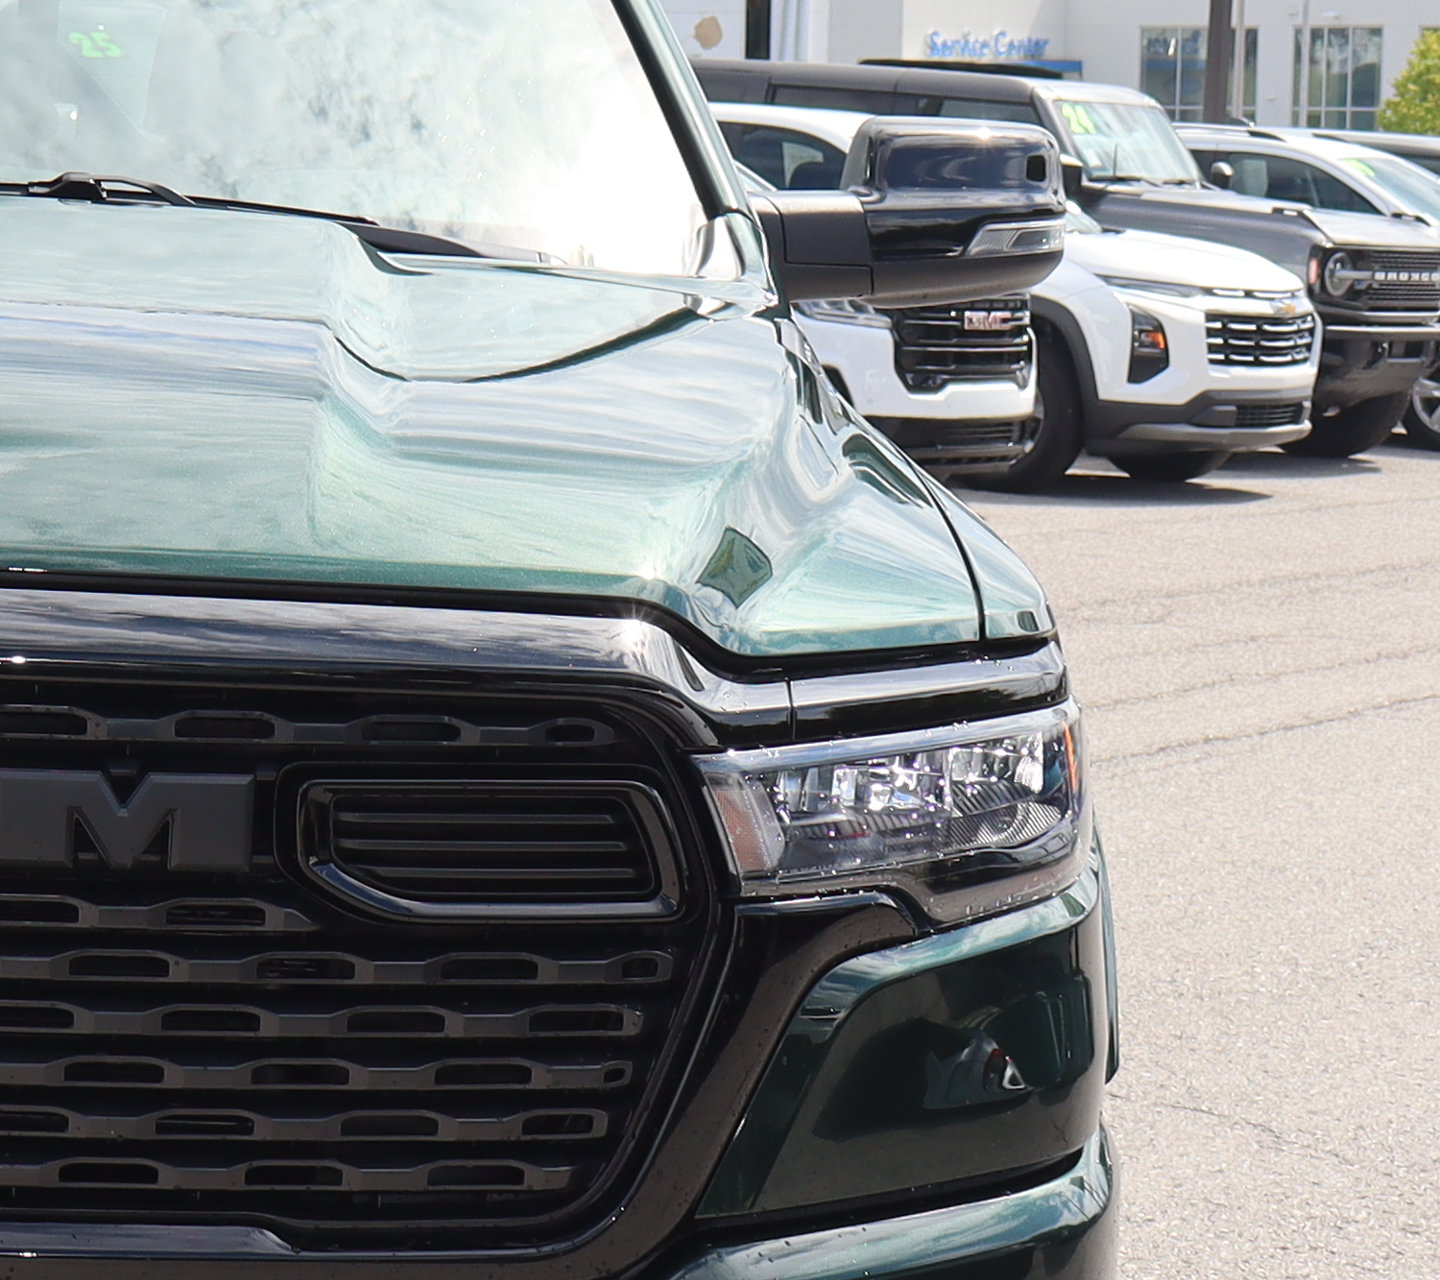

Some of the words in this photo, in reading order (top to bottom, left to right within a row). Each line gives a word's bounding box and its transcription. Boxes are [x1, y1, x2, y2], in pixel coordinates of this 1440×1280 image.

[68, 30, 123, 58] 25
[928, 30, 990, 58] Service
[993, 30, 1050, 58] Center
[963, 309, 1013, 330] GMC
